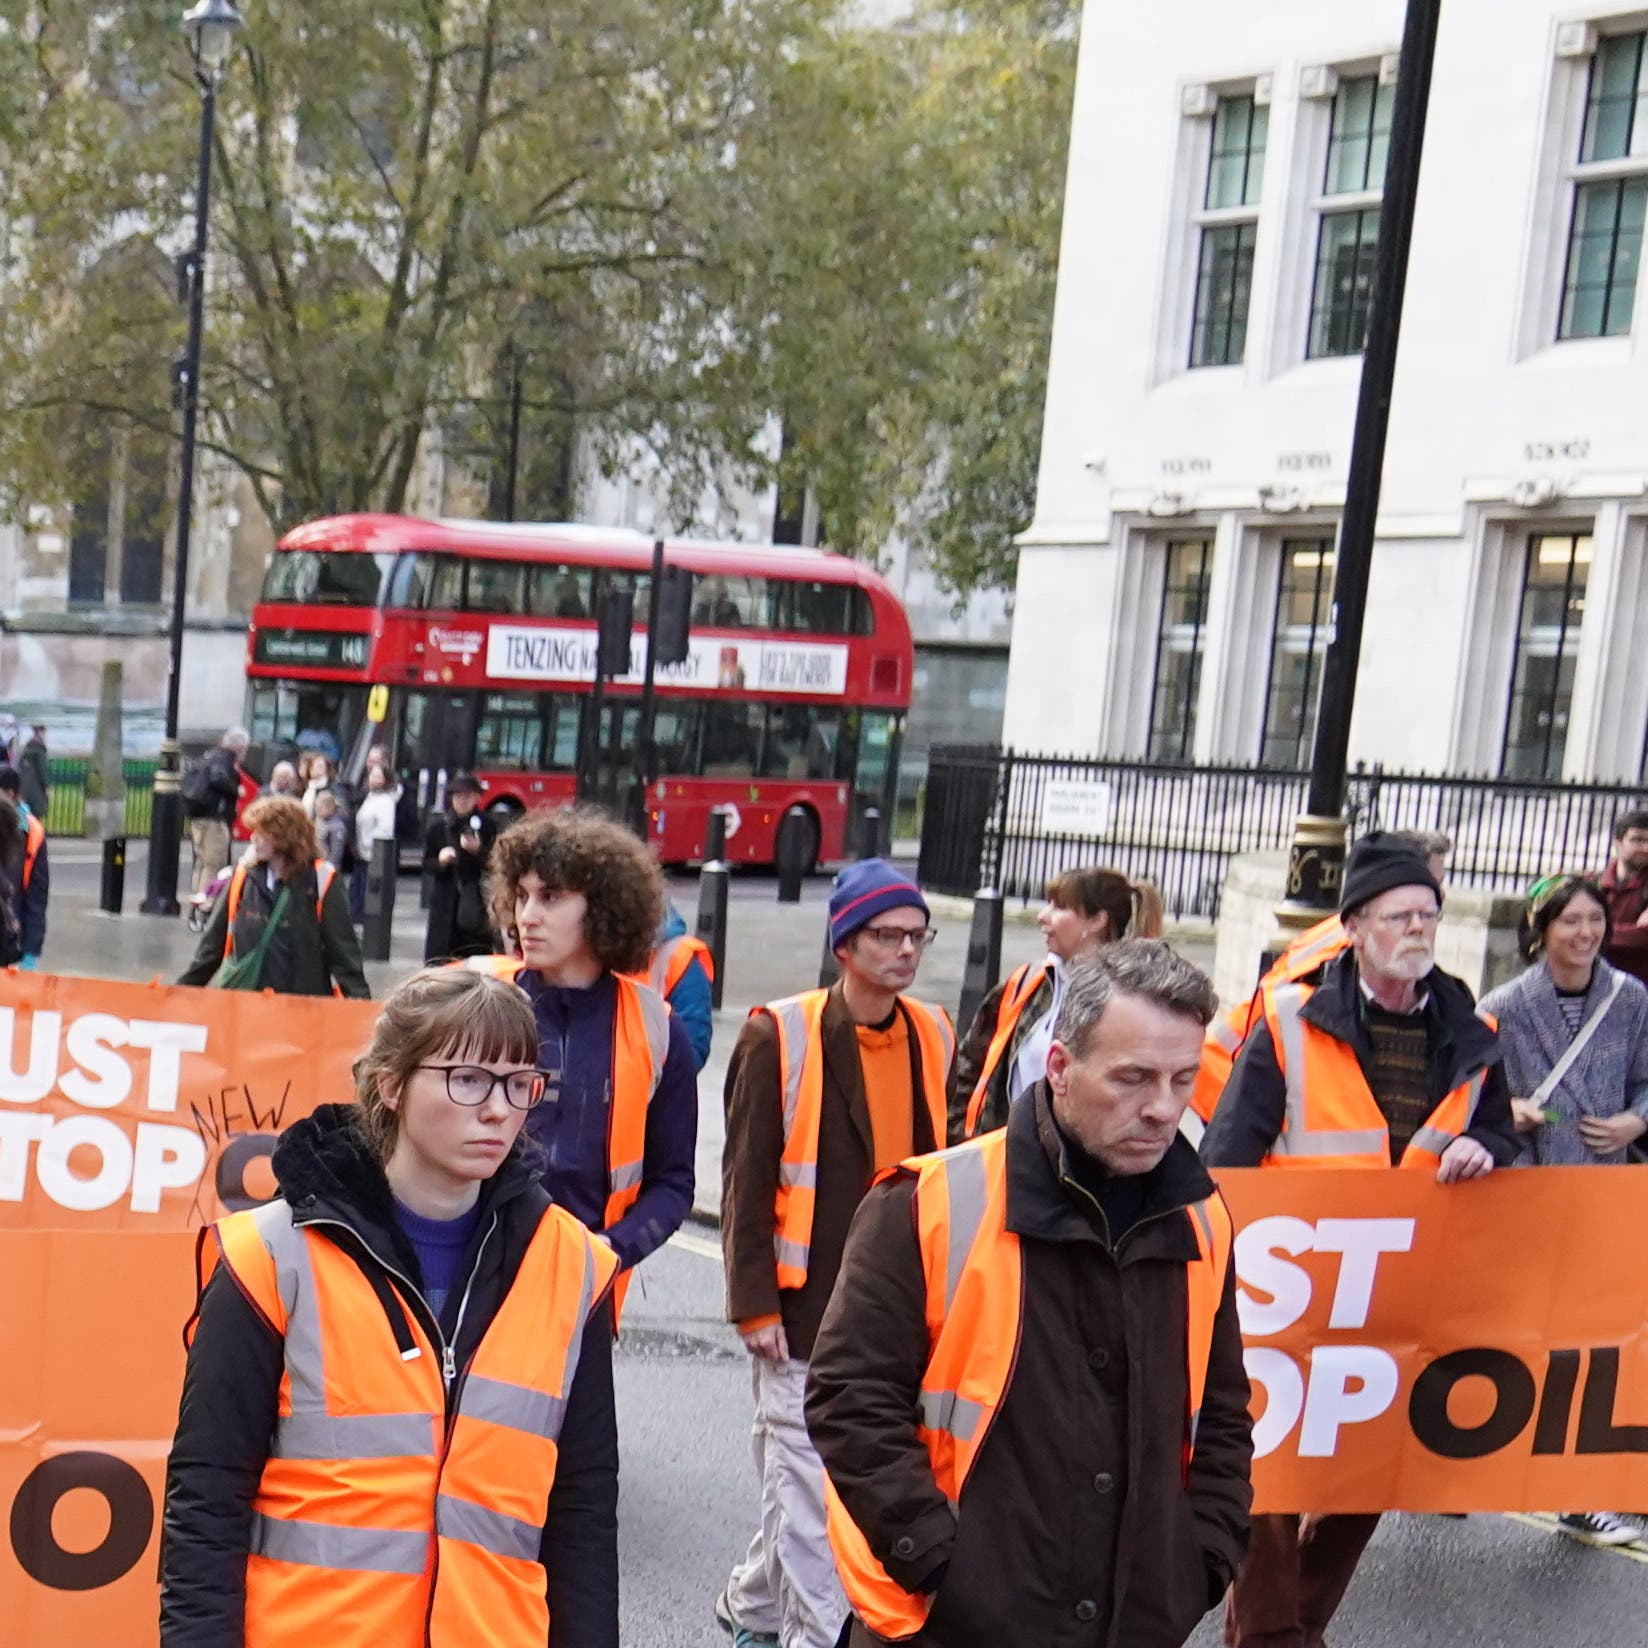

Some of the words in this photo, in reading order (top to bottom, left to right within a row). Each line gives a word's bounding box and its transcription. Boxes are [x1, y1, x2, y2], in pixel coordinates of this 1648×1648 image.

[506, 633, 577, 672] TENZING
[189, 1078, 292, 1151] NEW
[1234, 1215, 1417, 1336] ST
